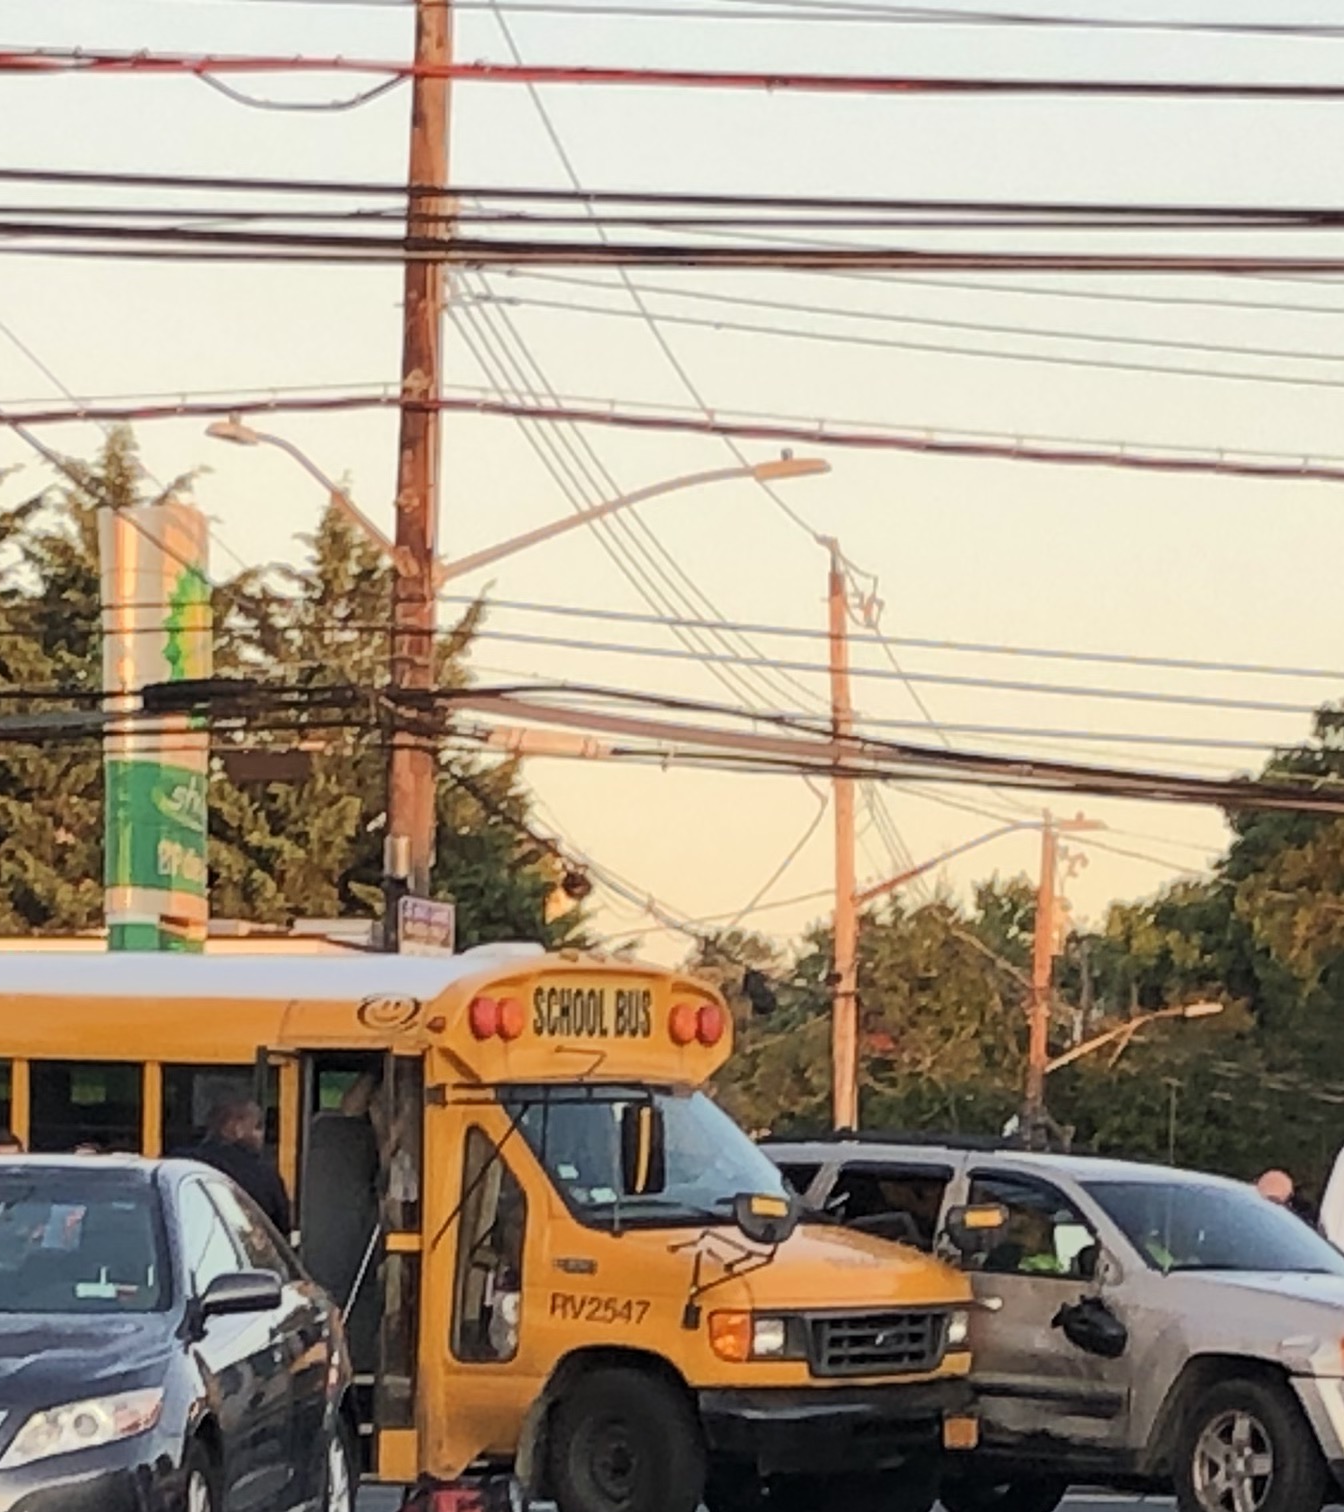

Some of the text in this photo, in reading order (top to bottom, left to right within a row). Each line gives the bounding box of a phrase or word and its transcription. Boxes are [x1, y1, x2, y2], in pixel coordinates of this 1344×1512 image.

[532, 986, 653, 1039] SCHOOL BUS
[550, 1291, 651, 1325] RV2547
